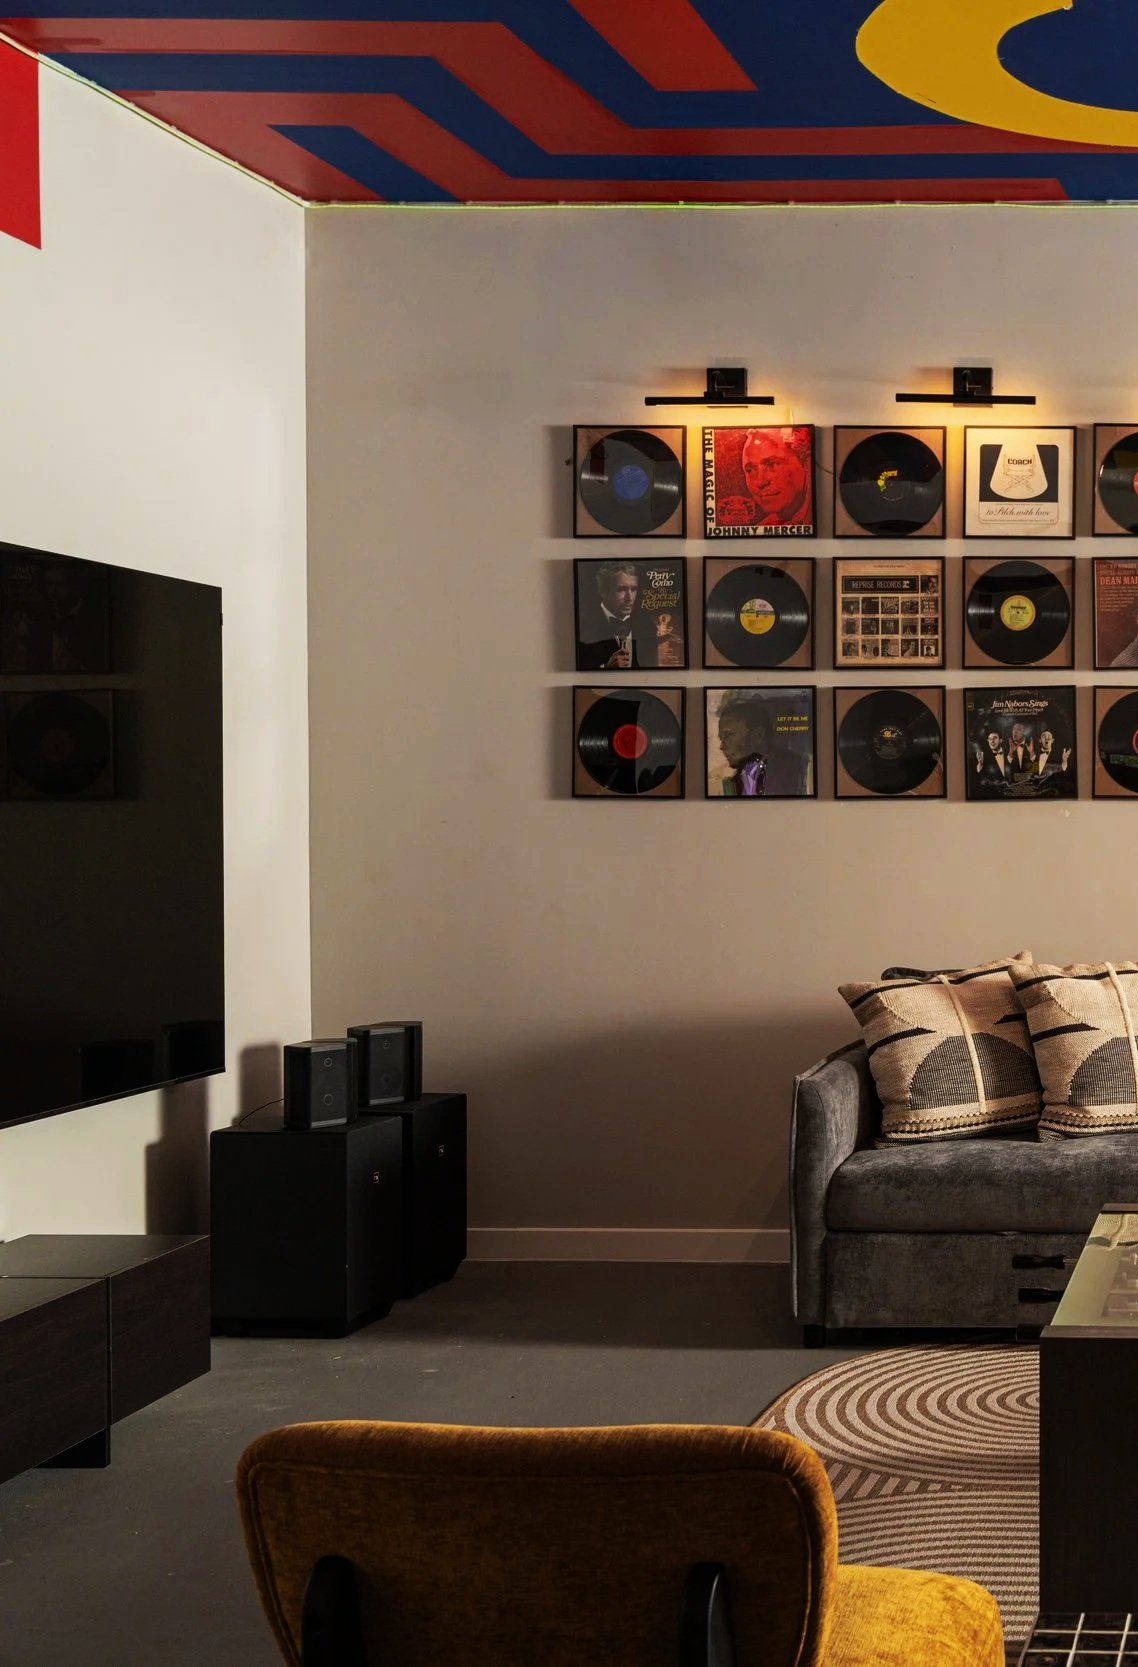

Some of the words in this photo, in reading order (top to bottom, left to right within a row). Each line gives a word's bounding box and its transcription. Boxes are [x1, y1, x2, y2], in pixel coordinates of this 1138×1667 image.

[704, 430, 713, 453] THE
[705, 460, 714, 501] MAGIC
[707, 508, 715, 523] OF
[708, 527, 758, 536] JOHNNY
[763, 526, 811, 535] MERCER
[652, 579, 674, 588] Como
[1100, 576, 1121, 585] DEAN
[991, 700, 1004, 709] Jim
[1005, 700, 1029, 708] Nabors
[1029, 700, 1048, 708] Sings
